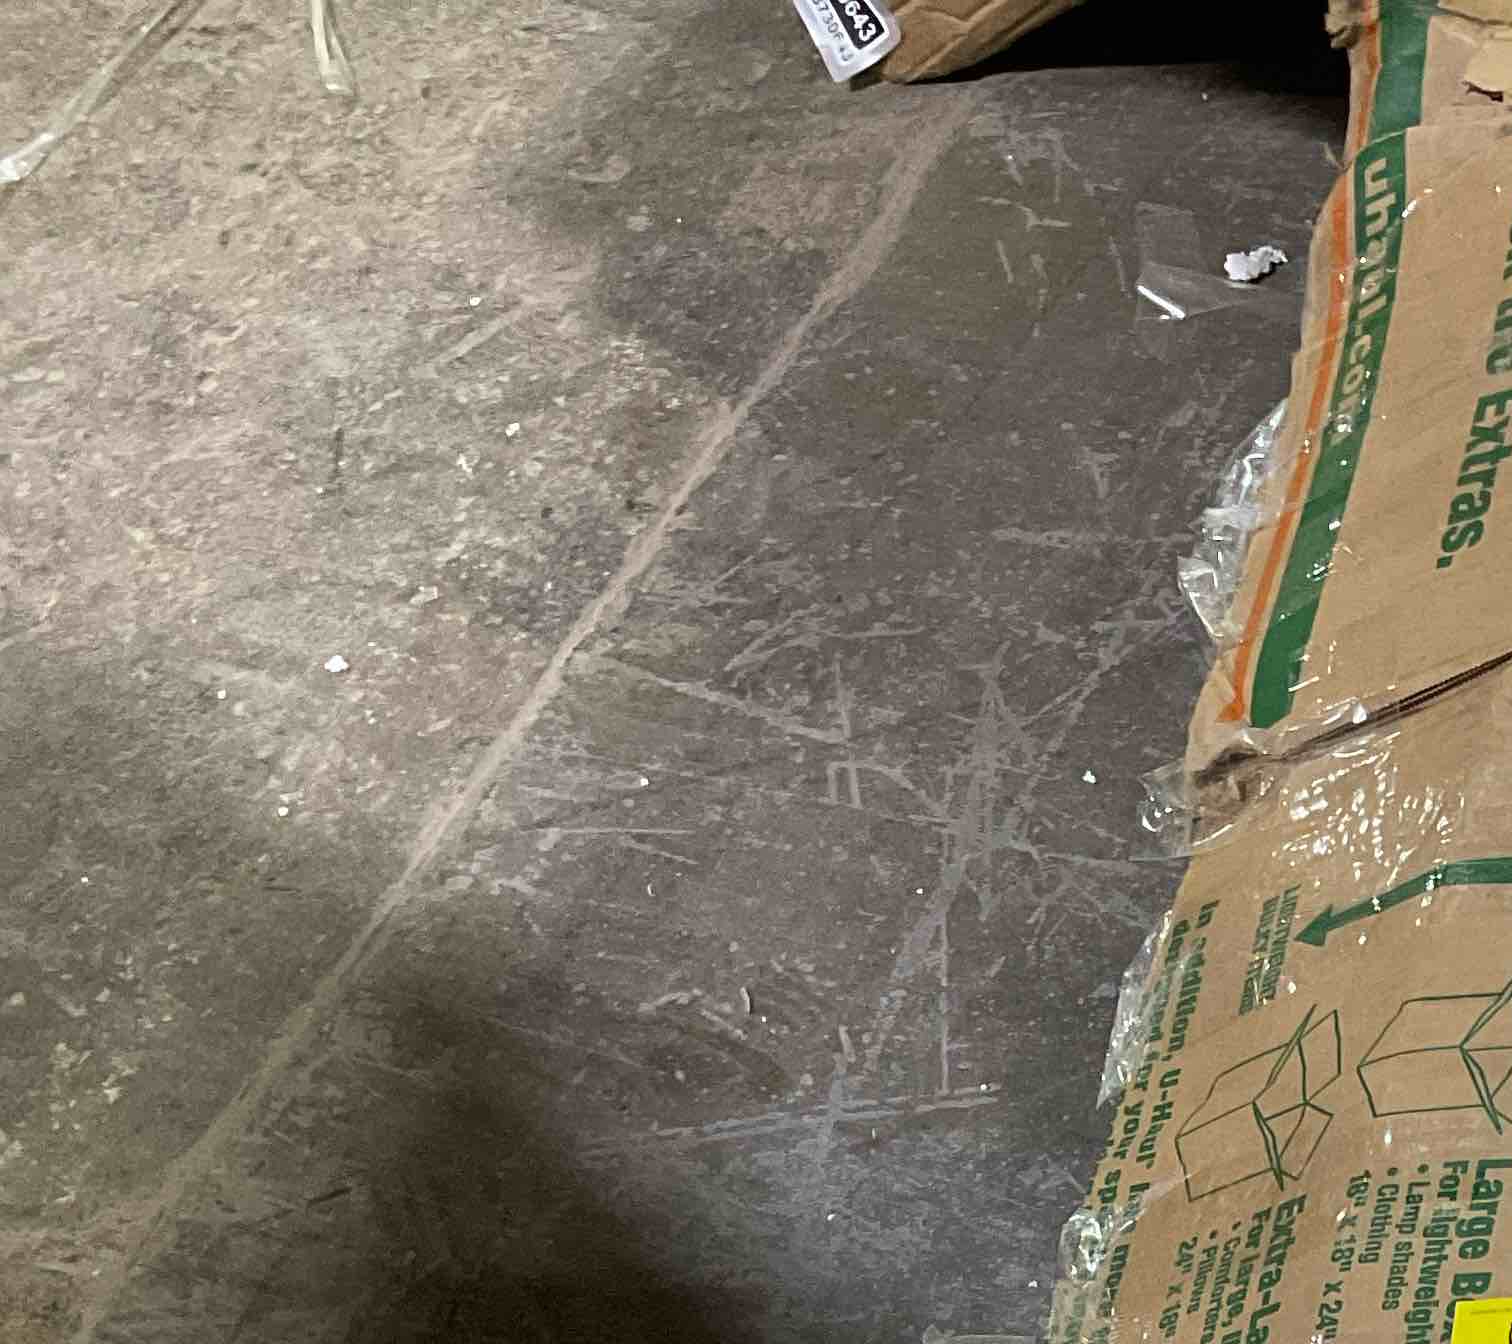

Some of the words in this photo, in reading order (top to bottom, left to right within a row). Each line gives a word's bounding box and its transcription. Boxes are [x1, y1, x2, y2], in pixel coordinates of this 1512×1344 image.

[1398, 1181, 1431, 1234] Lamp
[1438, 1161, 1469, 1201] For
[1359, 1184, 1399, 1263] Clothing
[1382, 1241, 1415, 1311] shades
